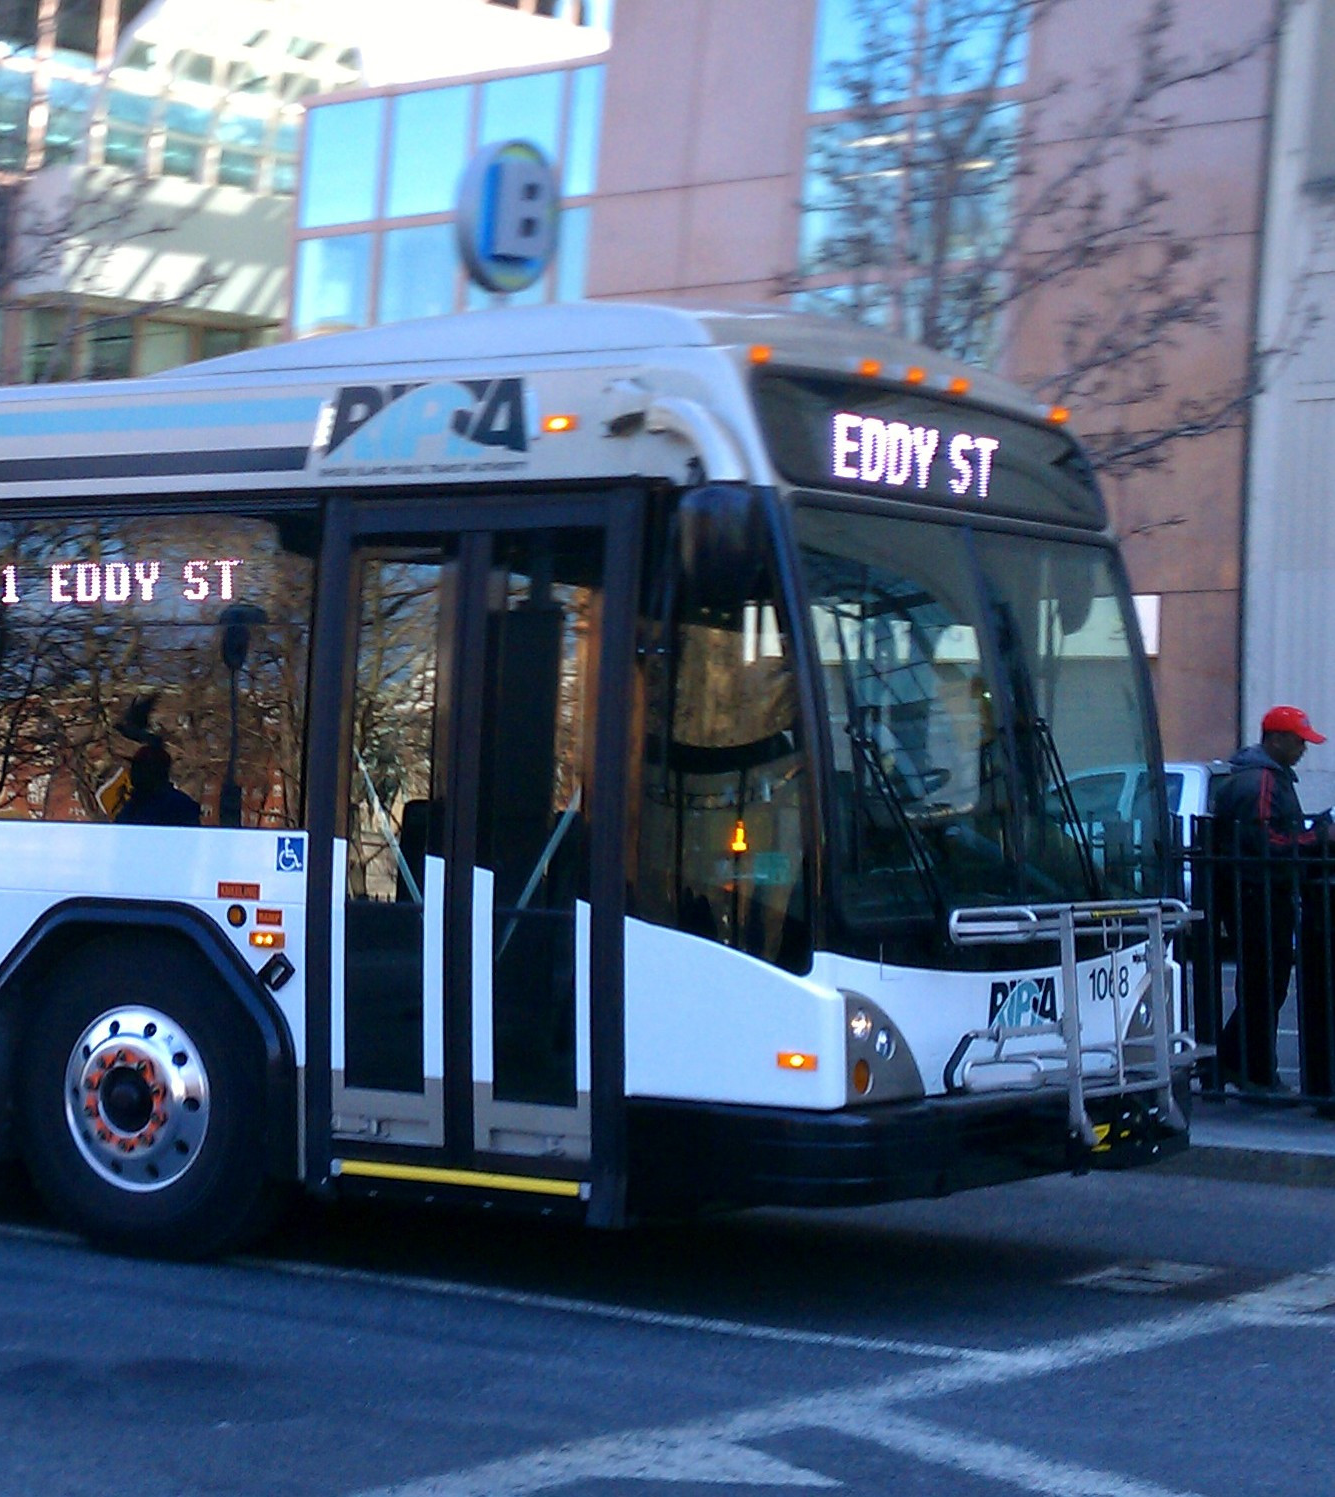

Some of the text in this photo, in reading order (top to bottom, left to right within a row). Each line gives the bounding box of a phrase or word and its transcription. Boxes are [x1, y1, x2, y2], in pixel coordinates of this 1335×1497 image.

[830, 411, 1001, 500] EDDY ST
[1, 559, 243, 603] 1 EDDY ST
